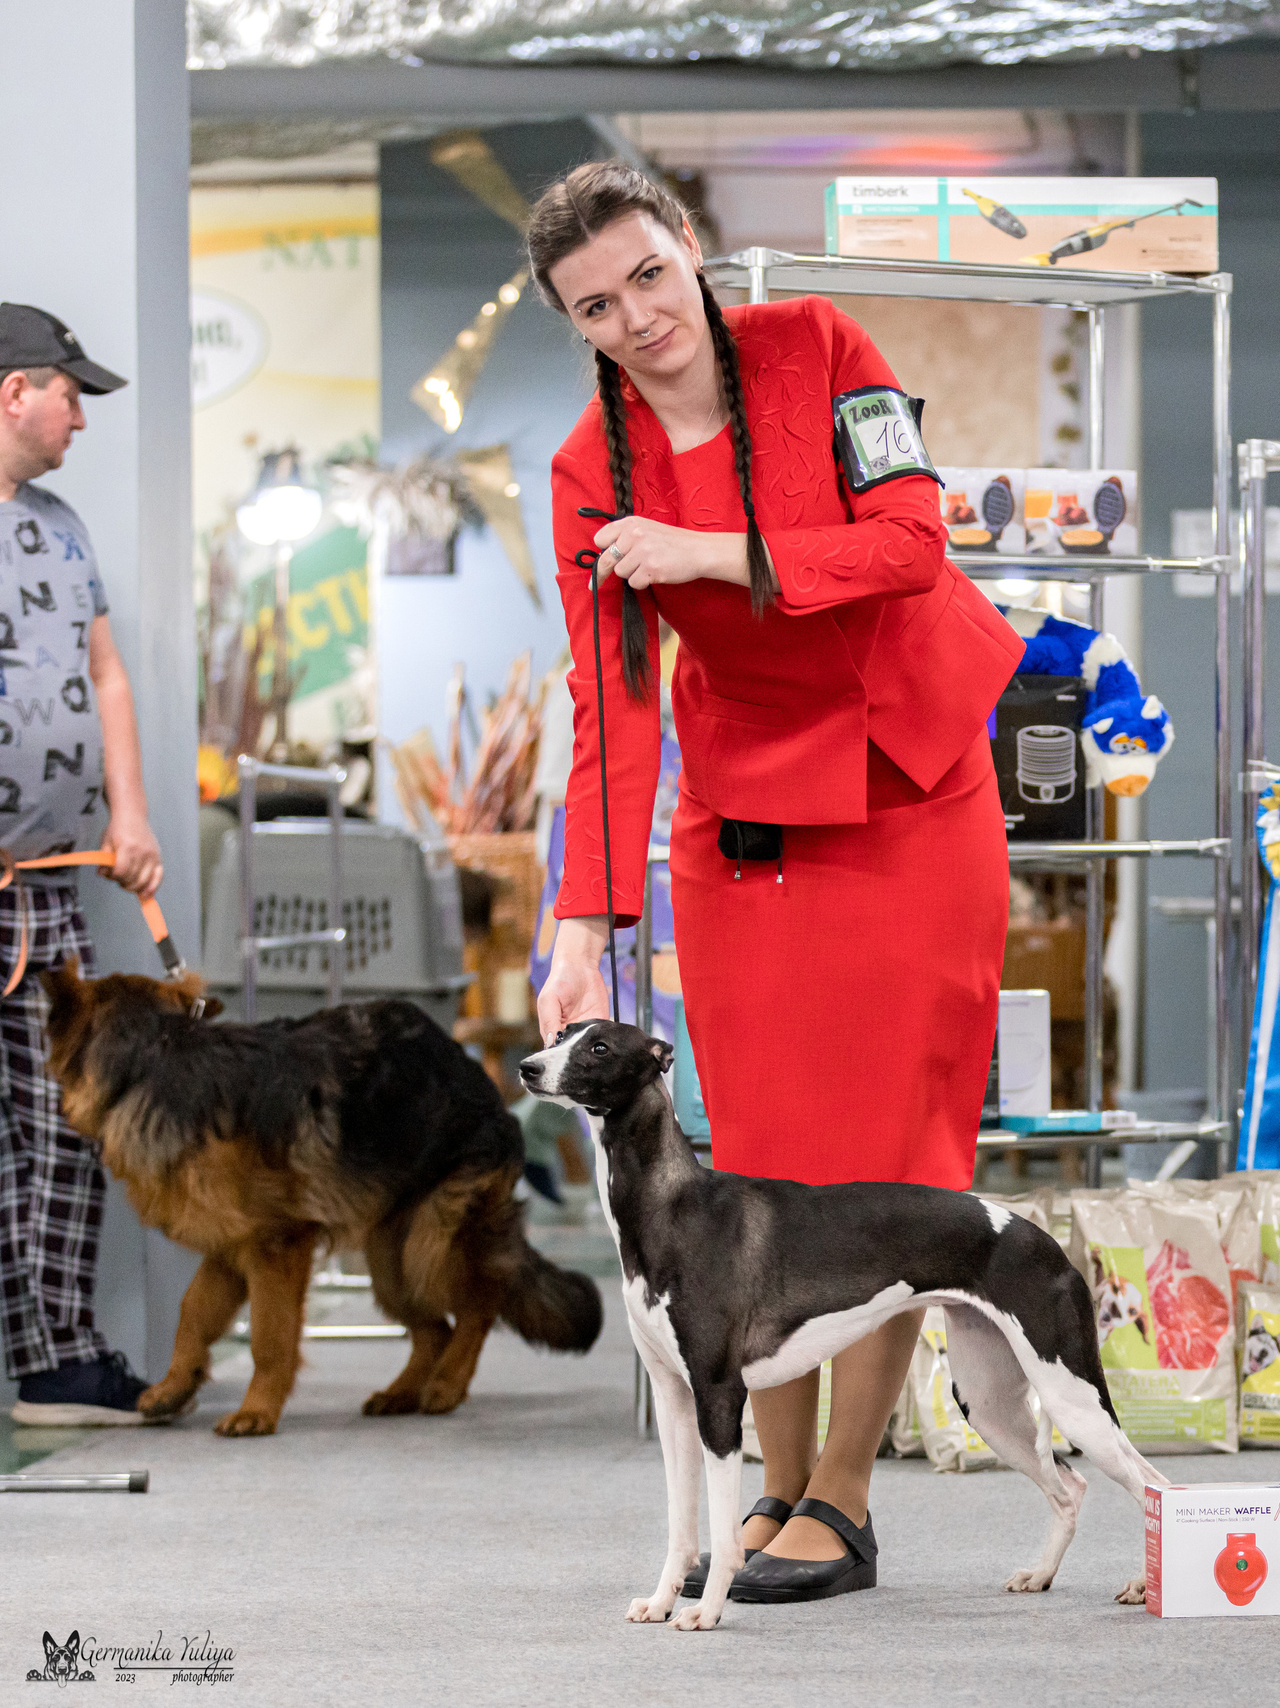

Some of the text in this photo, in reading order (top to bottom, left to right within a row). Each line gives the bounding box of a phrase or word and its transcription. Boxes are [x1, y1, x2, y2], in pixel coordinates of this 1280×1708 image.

[852, 184, 909, 197] timberk
[875, 419, 912, 459] 16
[1175, 1506, 1272, 1516] MINI MAKER WAFFLE
